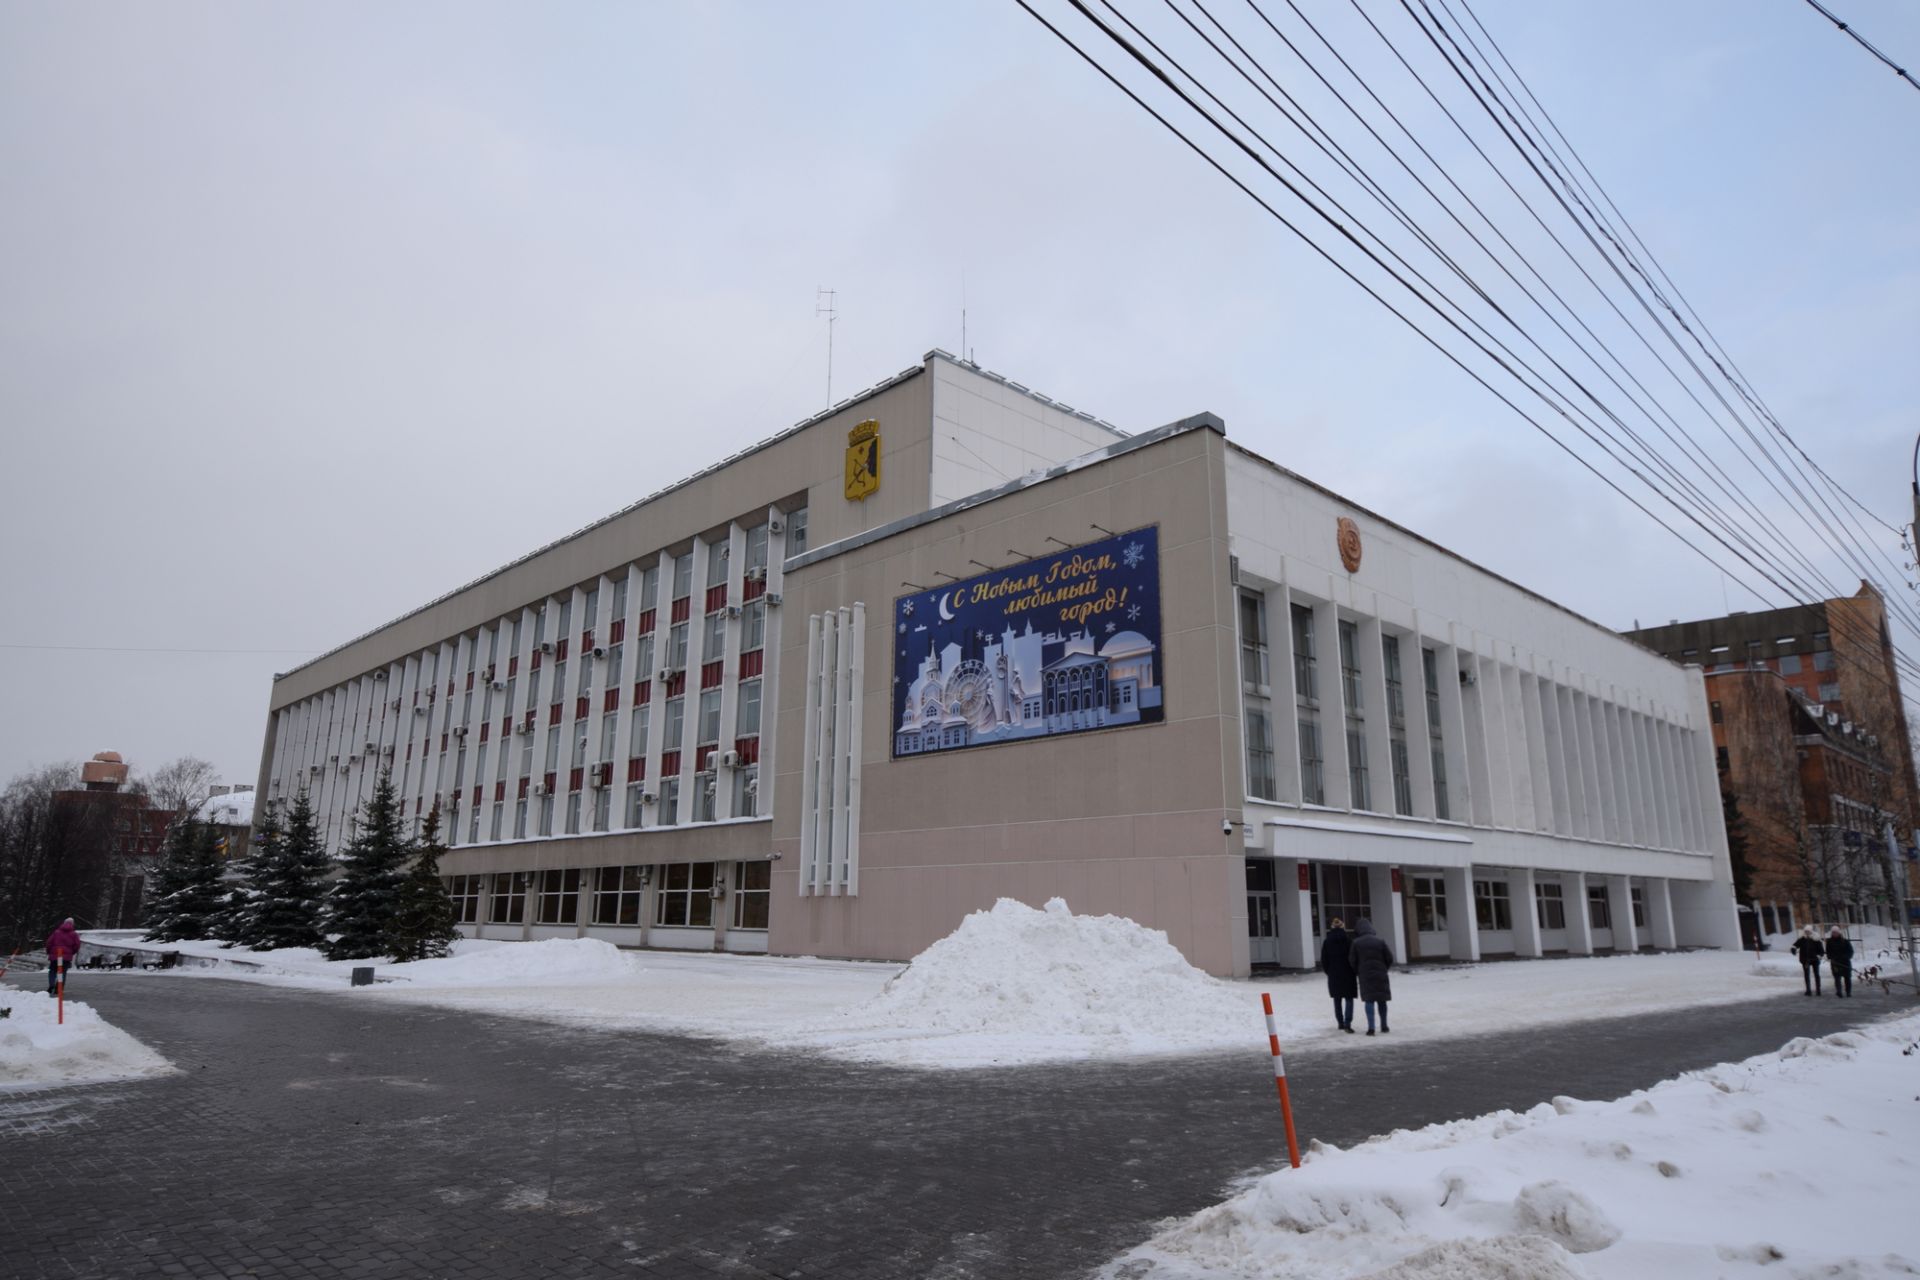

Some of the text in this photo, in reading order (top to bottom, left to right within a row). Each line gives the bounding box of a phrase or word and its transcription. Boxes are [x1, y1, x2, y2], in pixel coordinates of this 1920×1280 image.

[953, 554, 1117, 609] С Новым Годом,
[1003, 574, 1099, 615] любимый
[1059, 586, 1129, 625] город!
